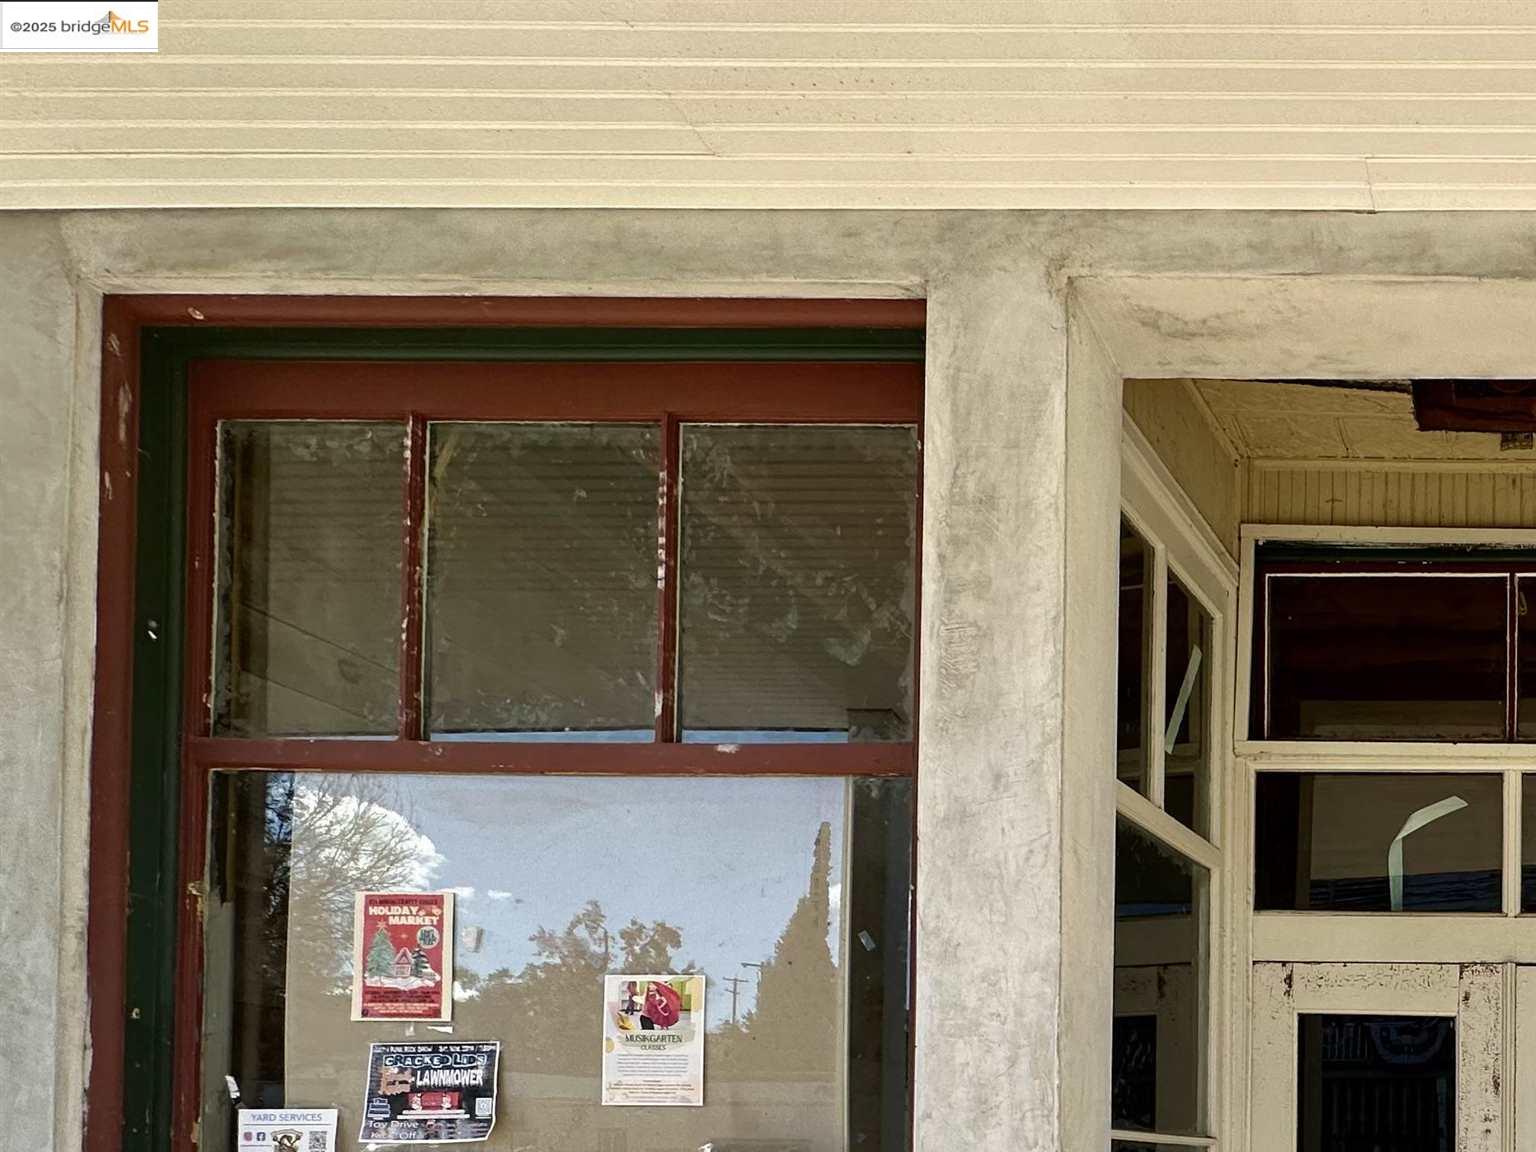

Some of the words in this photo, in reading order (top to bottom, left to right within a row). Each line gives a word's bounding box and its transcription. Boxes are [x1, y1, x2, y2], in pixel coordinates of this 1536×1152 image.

[368, 906, 419, 916] HOLIDAY
[388, 916, 439, 926] MARKET
[383, 1054, 451, 1067] CRACKED
[416, 1069, 484, 1087] LAWNMOWER
[251, 1113, 277, 1121] YARD
[279, 1113, 322, 1121] SERVICES
